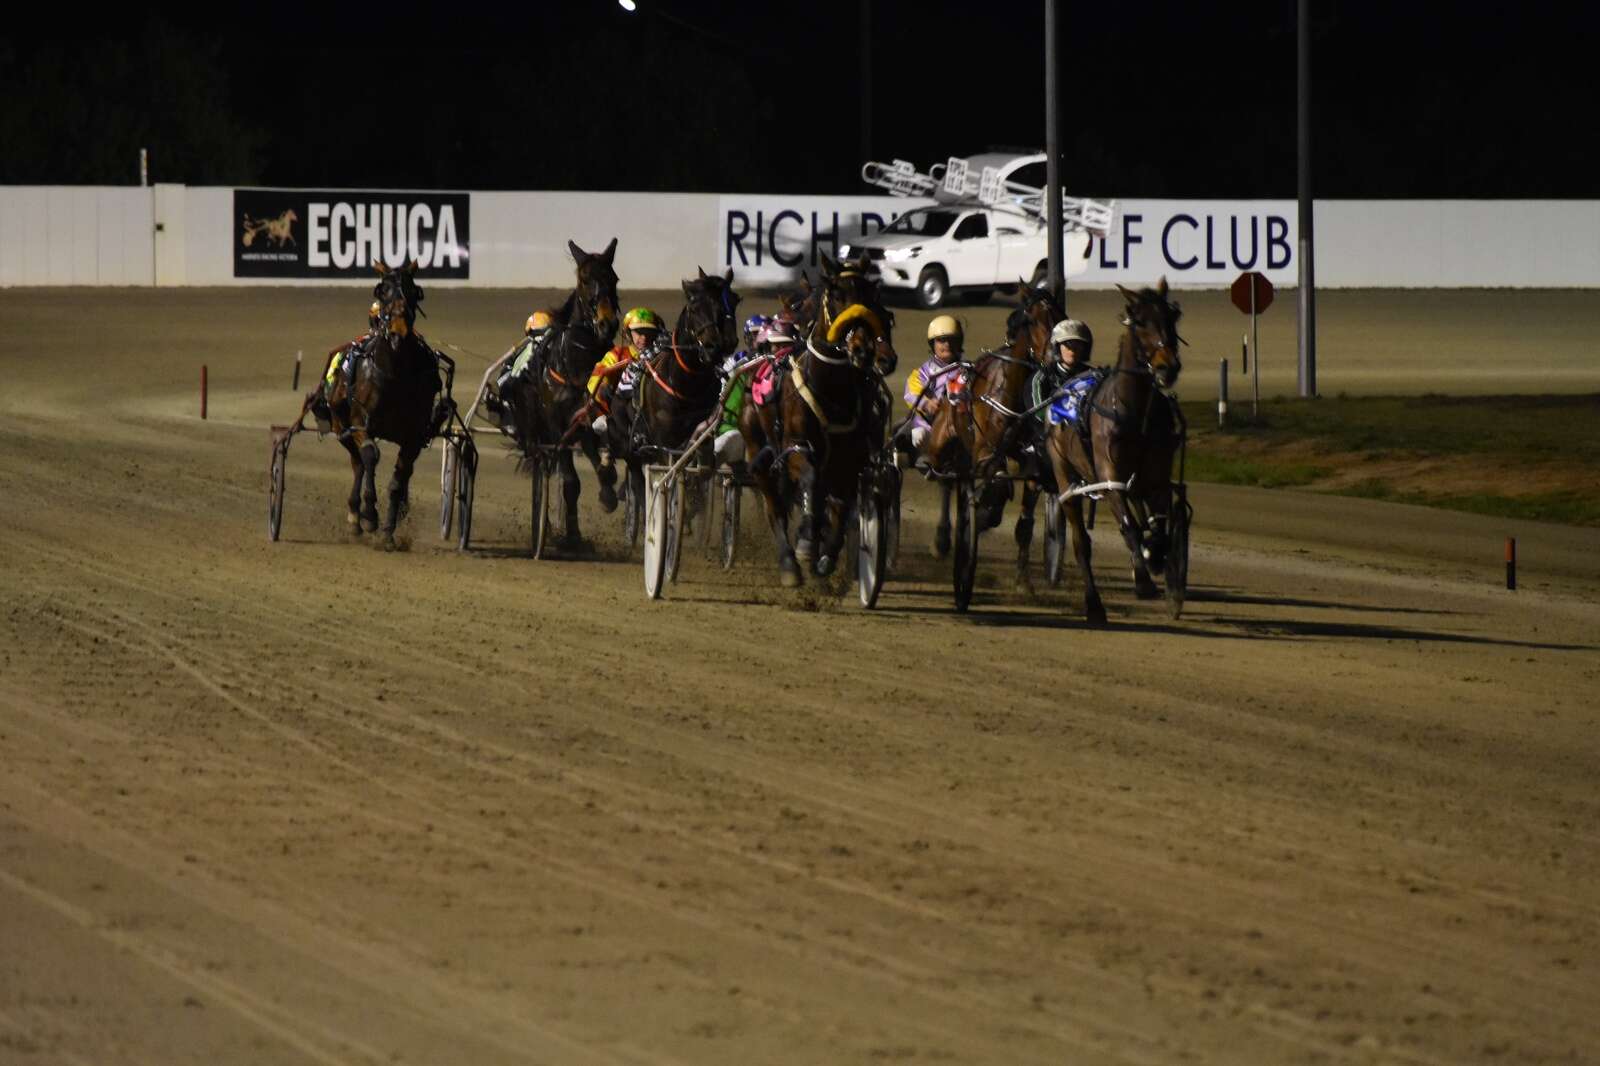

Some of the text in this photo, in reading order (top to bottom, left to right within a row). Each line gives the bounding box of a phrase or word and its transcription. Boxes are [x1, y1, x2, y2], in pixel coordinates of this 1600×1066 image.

[308, 202, 461, 269] ECHUCA
[726, 209, 839, 267] RICH
[1161, 213, 1292, 270] CLUB
